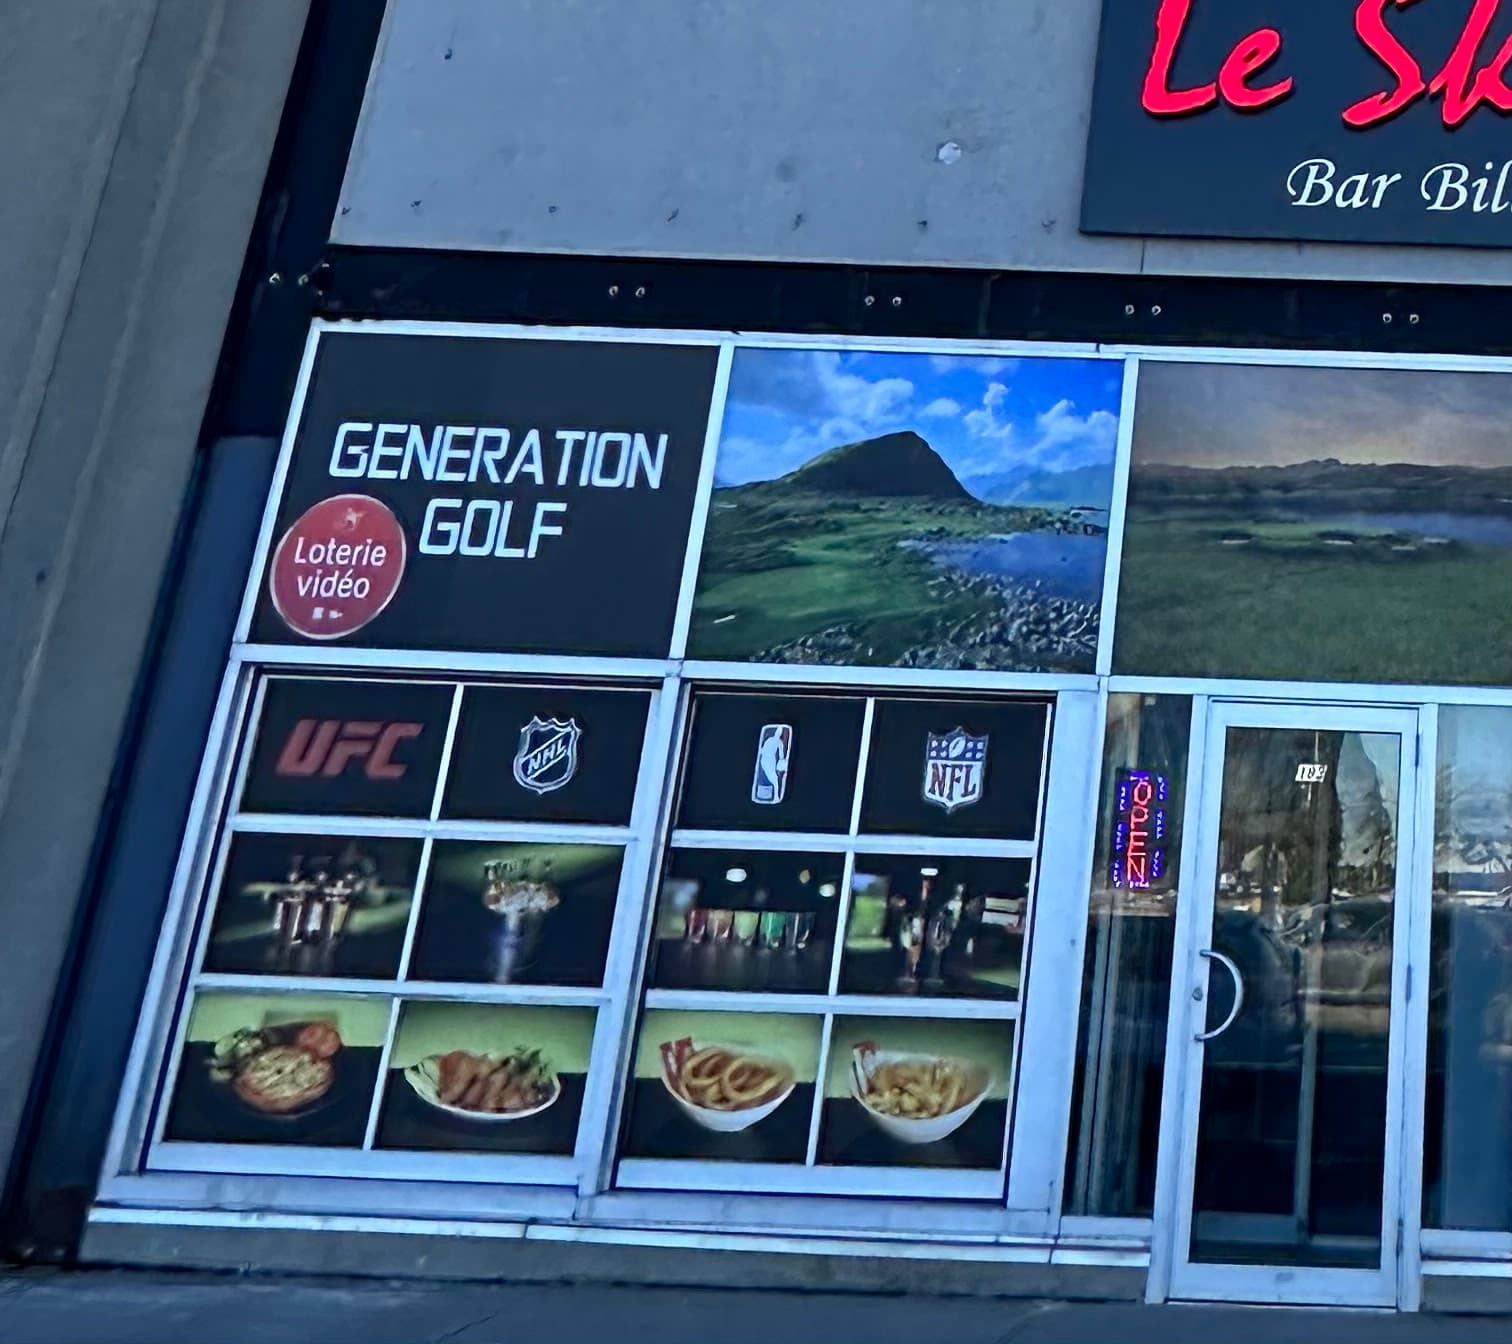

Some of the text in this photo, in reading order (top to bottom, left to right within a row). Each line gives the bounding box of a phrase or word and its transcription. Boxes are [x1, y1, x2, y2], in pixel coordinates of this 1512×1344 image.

[1286, 158, 1402, 209] Bar
[329, 422, 669, 489] GENERATION
[294, 536, 387, 566] Loterie
[418, 498, 568, 559] GOLF
[297, 568, 371, 599] vidéo
[276, 719, 425, 779] UFC
[527, 737, 567, 776] NHL
[928, 763, 978, 801] NFL
[1126, 780, 1153, 883] OPEN
